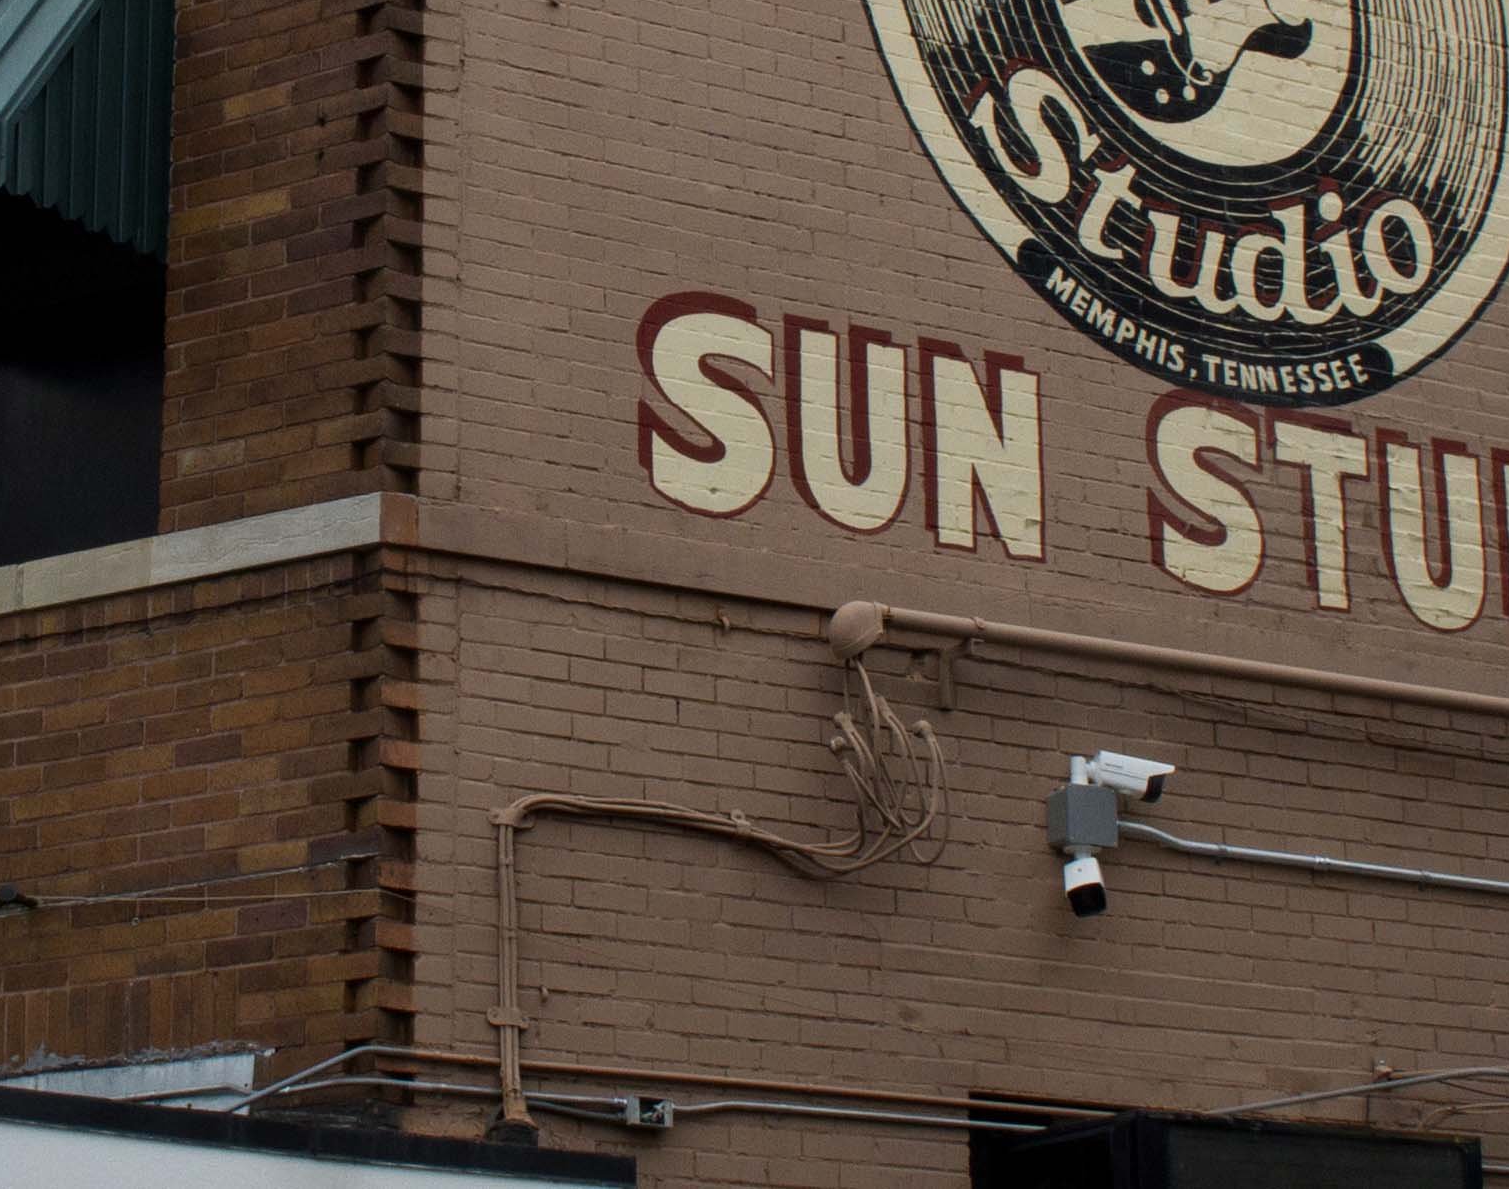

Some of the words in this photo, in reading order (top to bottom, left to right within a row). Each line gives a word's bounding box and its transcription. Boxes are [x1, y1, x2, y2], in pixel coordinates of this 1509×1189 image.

[968, 66, 1435, 324] Studio
[638, 291, 1046, 563] SUN
[1202, 354, 1370, 394] TENNESSEE
